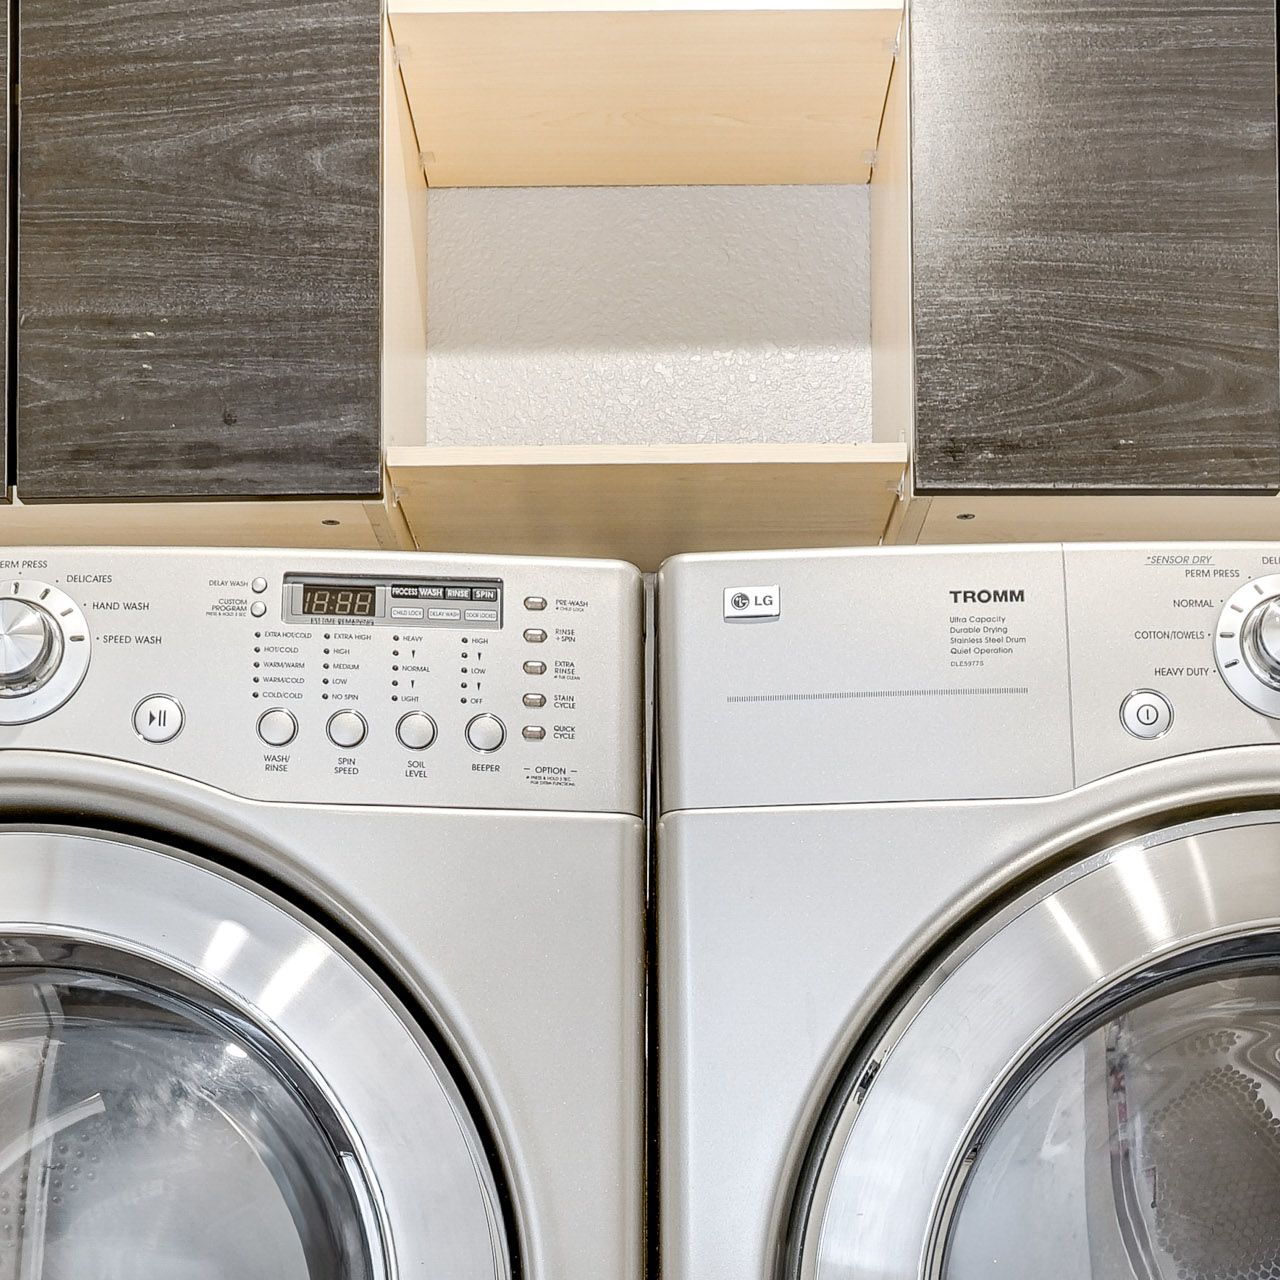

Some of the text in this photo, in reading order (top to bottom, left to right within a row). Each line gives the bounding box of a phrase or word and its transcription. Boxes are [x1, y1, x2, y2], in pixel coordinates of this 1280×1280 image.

[1191, 555, 1212, 564] DRY
[22, 560, 48, 569] PRESS
[1185, 569, 1240, 578] PERM PRESS
[67, 575, 112, 583] DELICATES
[392, 588, 418, 596] PROCESS
[419, 588, 443, 596] WASH
[447, 589, 469, 597] RINSE
[476, 590, 494, 598] SPIN
[949, 590, 1025, 603] TROMM
[555, 599, 589, 607] PRE-WASH
[755, 596, 773, 606] LG
[1173, 599, 1214, 608] NORMAL
[92, 602, 149, 611] HAND WASH
[969, 616, 1006, 624] Capacity
[555, 628, 575, 636] RINSE
[983, 626, 1008, 634] Drying
[103, 635, 162, 644] SPEED WASH
[1134, 630, 1204, 640] COTTON/TOWELS
[974, 647, 1013, 655] Operation
[1154, 667, 1209, 677] HEAVY DUTY
[263, 754, 290, 763] WASH/
[338, 757, 356, 766] SPIN
[265, 764, 288, 772] RINSE
[408, 760, 425, 769] SOIL
[472, 764, 500, 772] BEEPER
[334, 766, 359, 775] SPEED
[405, 769, 428, 778] LEVEL
[535, 766, 566, 775] OPTION
